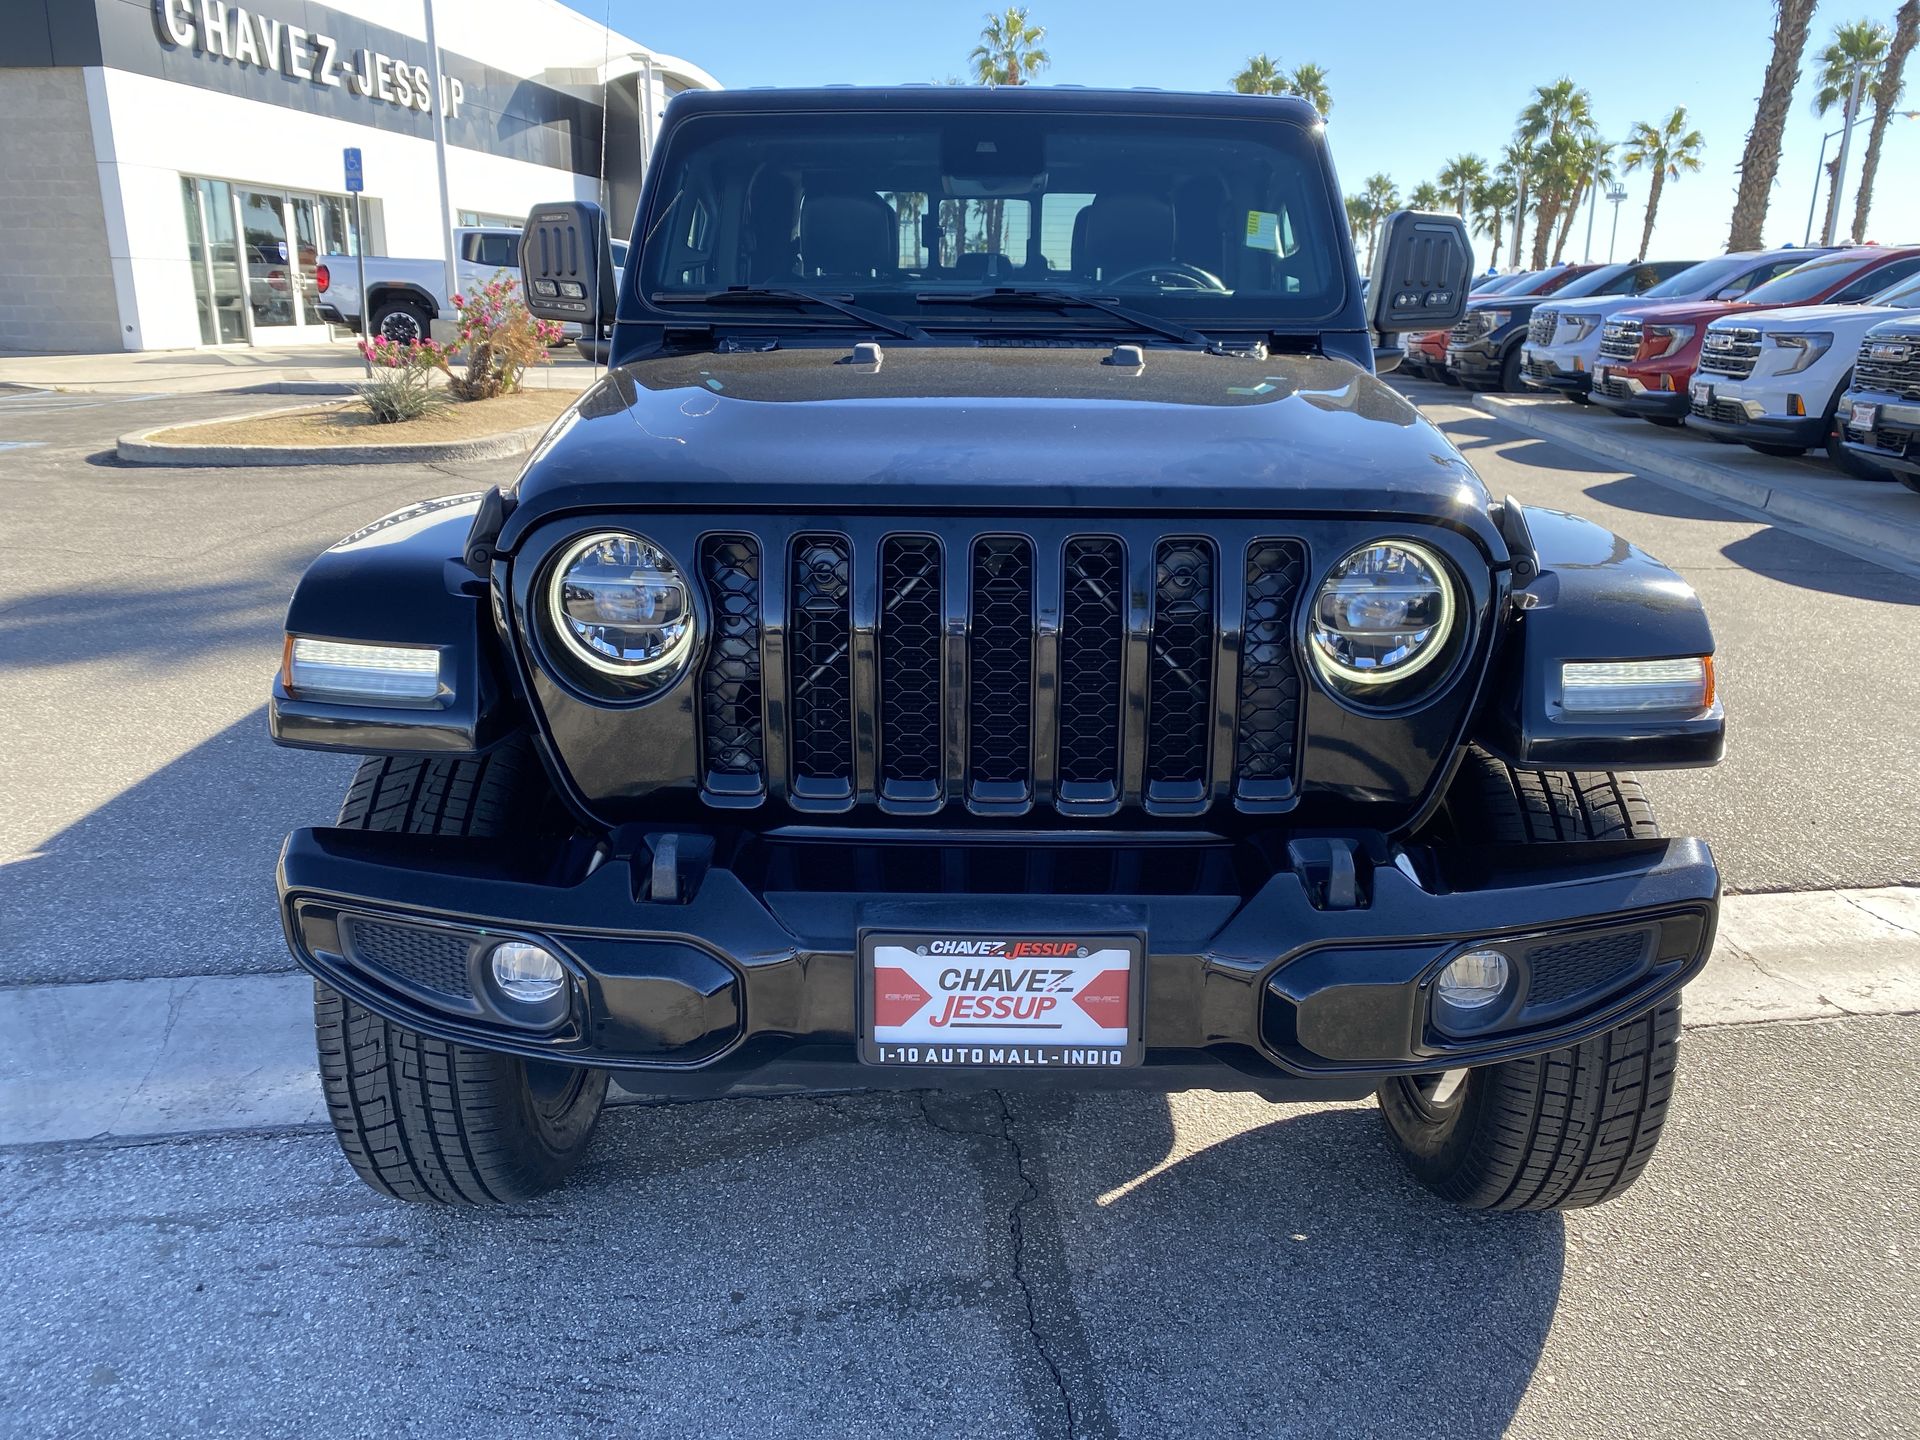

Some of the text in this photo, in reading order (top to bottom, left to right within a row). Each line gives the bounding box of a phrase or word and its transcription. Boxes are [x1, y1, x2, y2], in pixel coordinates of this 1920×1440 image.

[930, 940, 1078, 960] CHAVEZ JESSUP
[939, 968, 1077, 992] CHAVEZ
[885, 993, 920, 1001] GMC
[1084, 995, 1120, 1003] GMC
[929, 995, 1057, 1027] JESSUP
[879, 1047, 918, 1063] I-10
